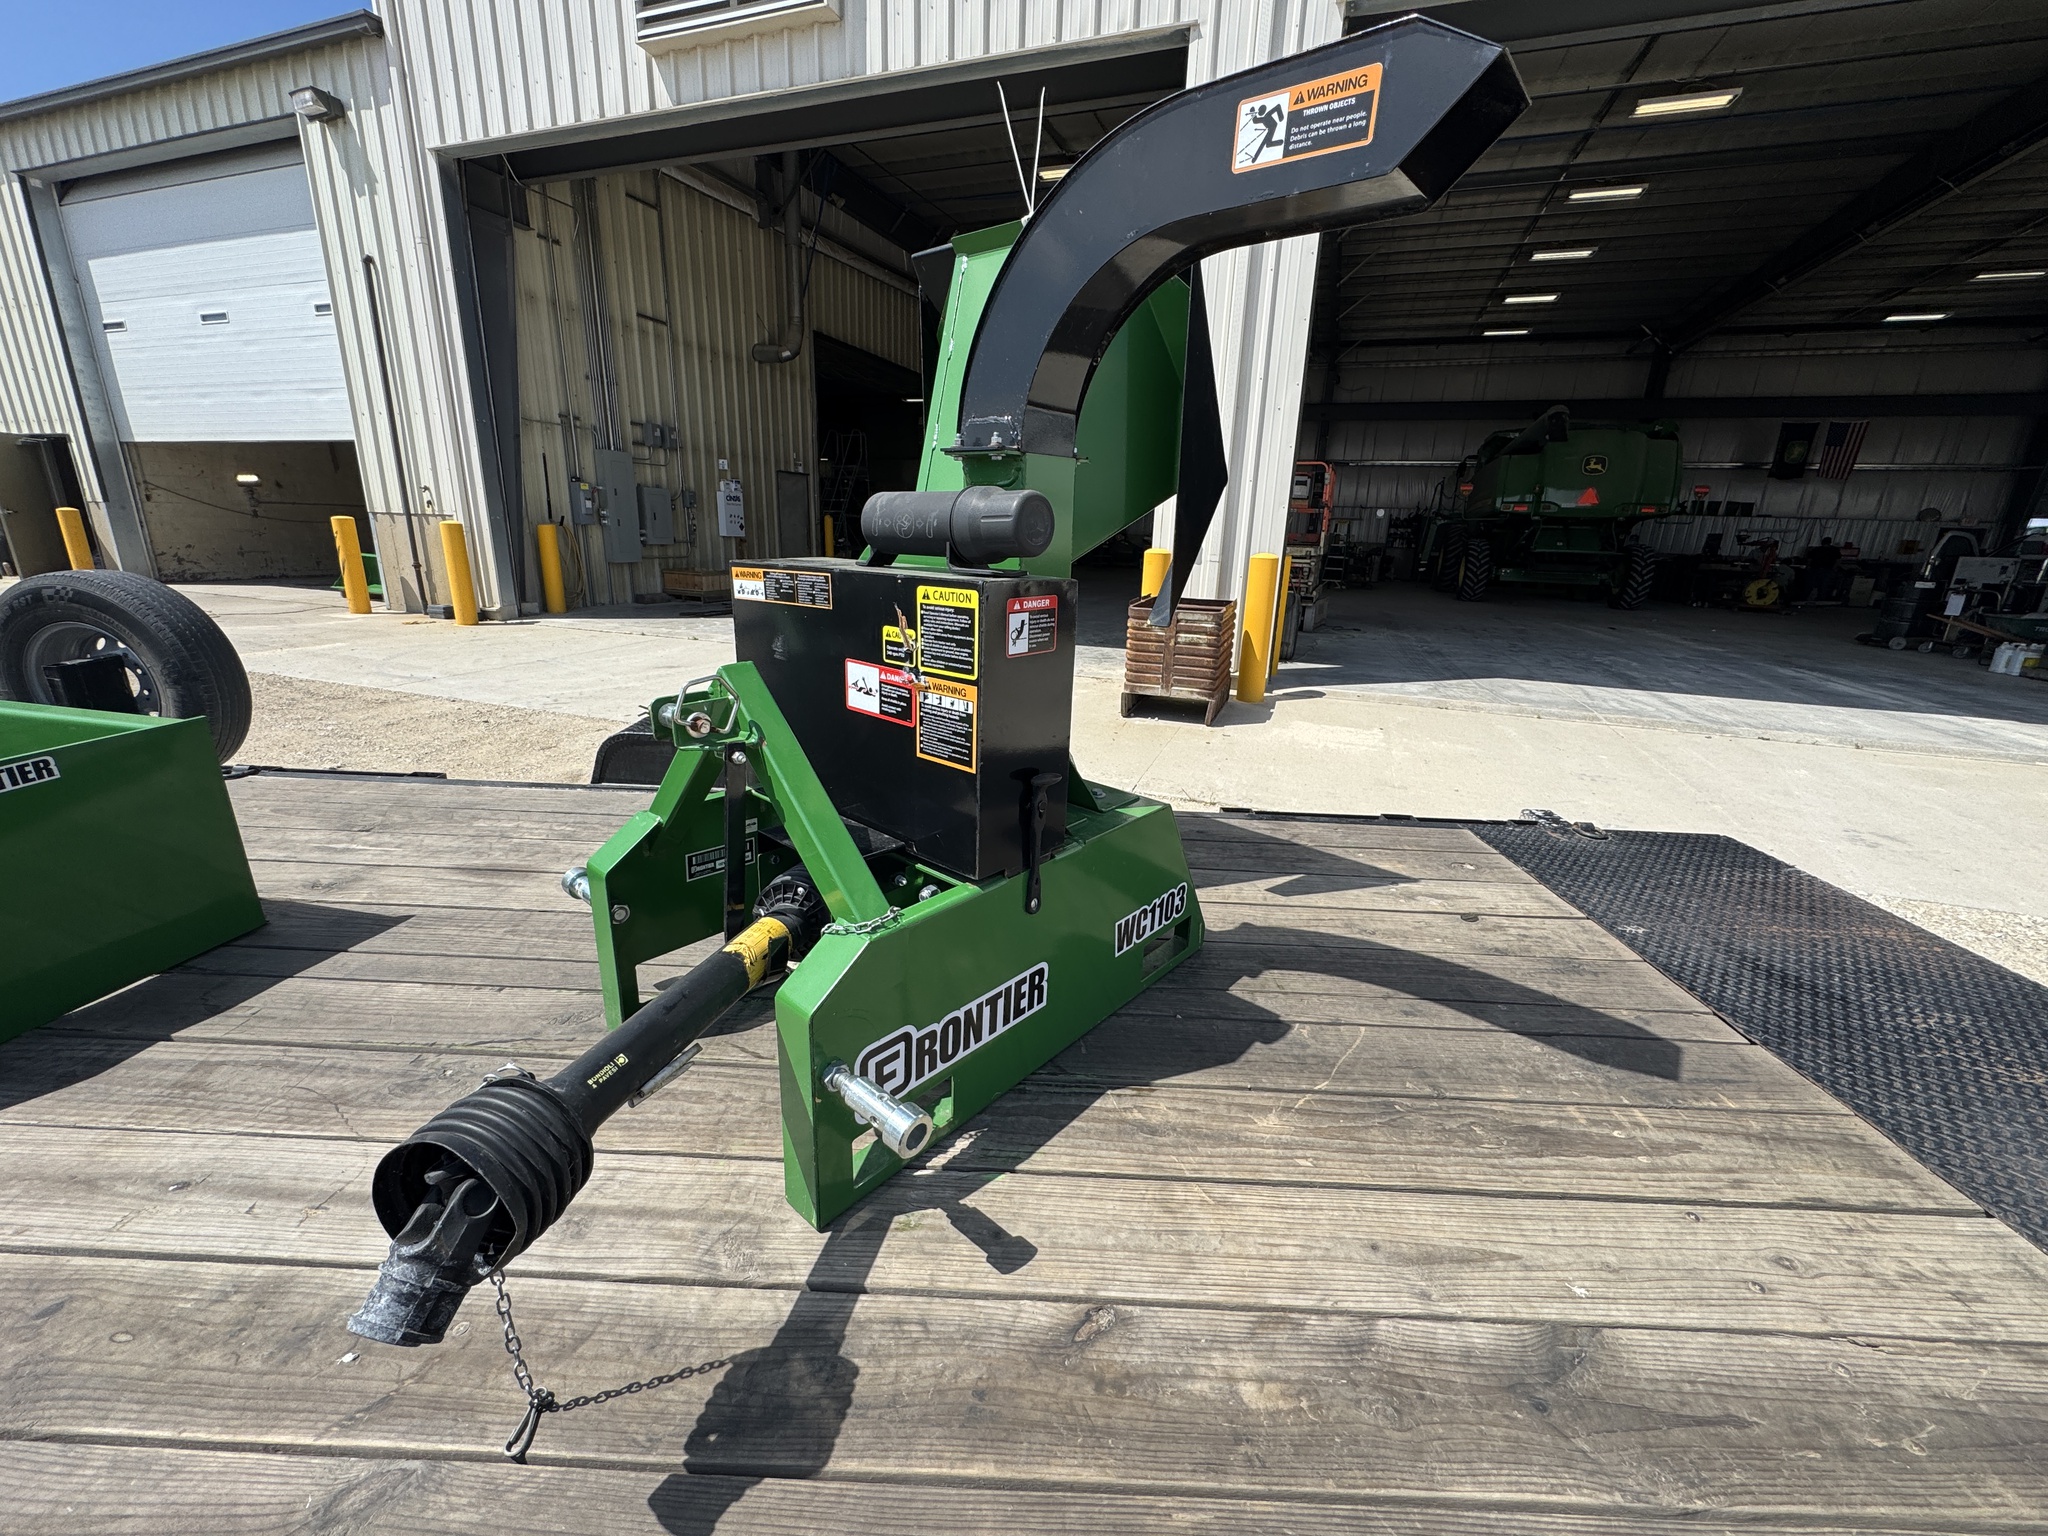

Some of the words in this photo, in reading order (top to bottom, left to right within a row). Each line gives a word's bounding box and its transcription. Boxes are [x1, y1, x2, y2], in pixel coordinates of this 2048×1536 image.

[1306, 74, 1368, 101] WARNING
[1303, 103, 1329, 117] THROWN
[1329, 97, 1356, 110] OBJECTS
[1289, 132, 1307, 142] Debris
[1327, 123, 1347, 134] thrown
[1352, 119, 1367, 129] long
[1299, 123, 1309, 132] not
[1310, 119, 1332, 131] operate
[1332, 116, 1345, 124] near
[1345, 110, 1367, 122] people.
[1288, 139, 1313, 150] distance.
[739, 570, 762, 580] WARNING
[932, 590, 972, 604] CAUTION
[1023, 599, 1050, 609] DANGER
[931, 682, 967, 697] WARNING
[1116, 884, 1188, 956] WC1103
[859, 966, 1047, 1097] FRONTIER
[587, 1061, 615, 1085] BONDIOLI
[598, 1066, 619, 1084] PAVESI
